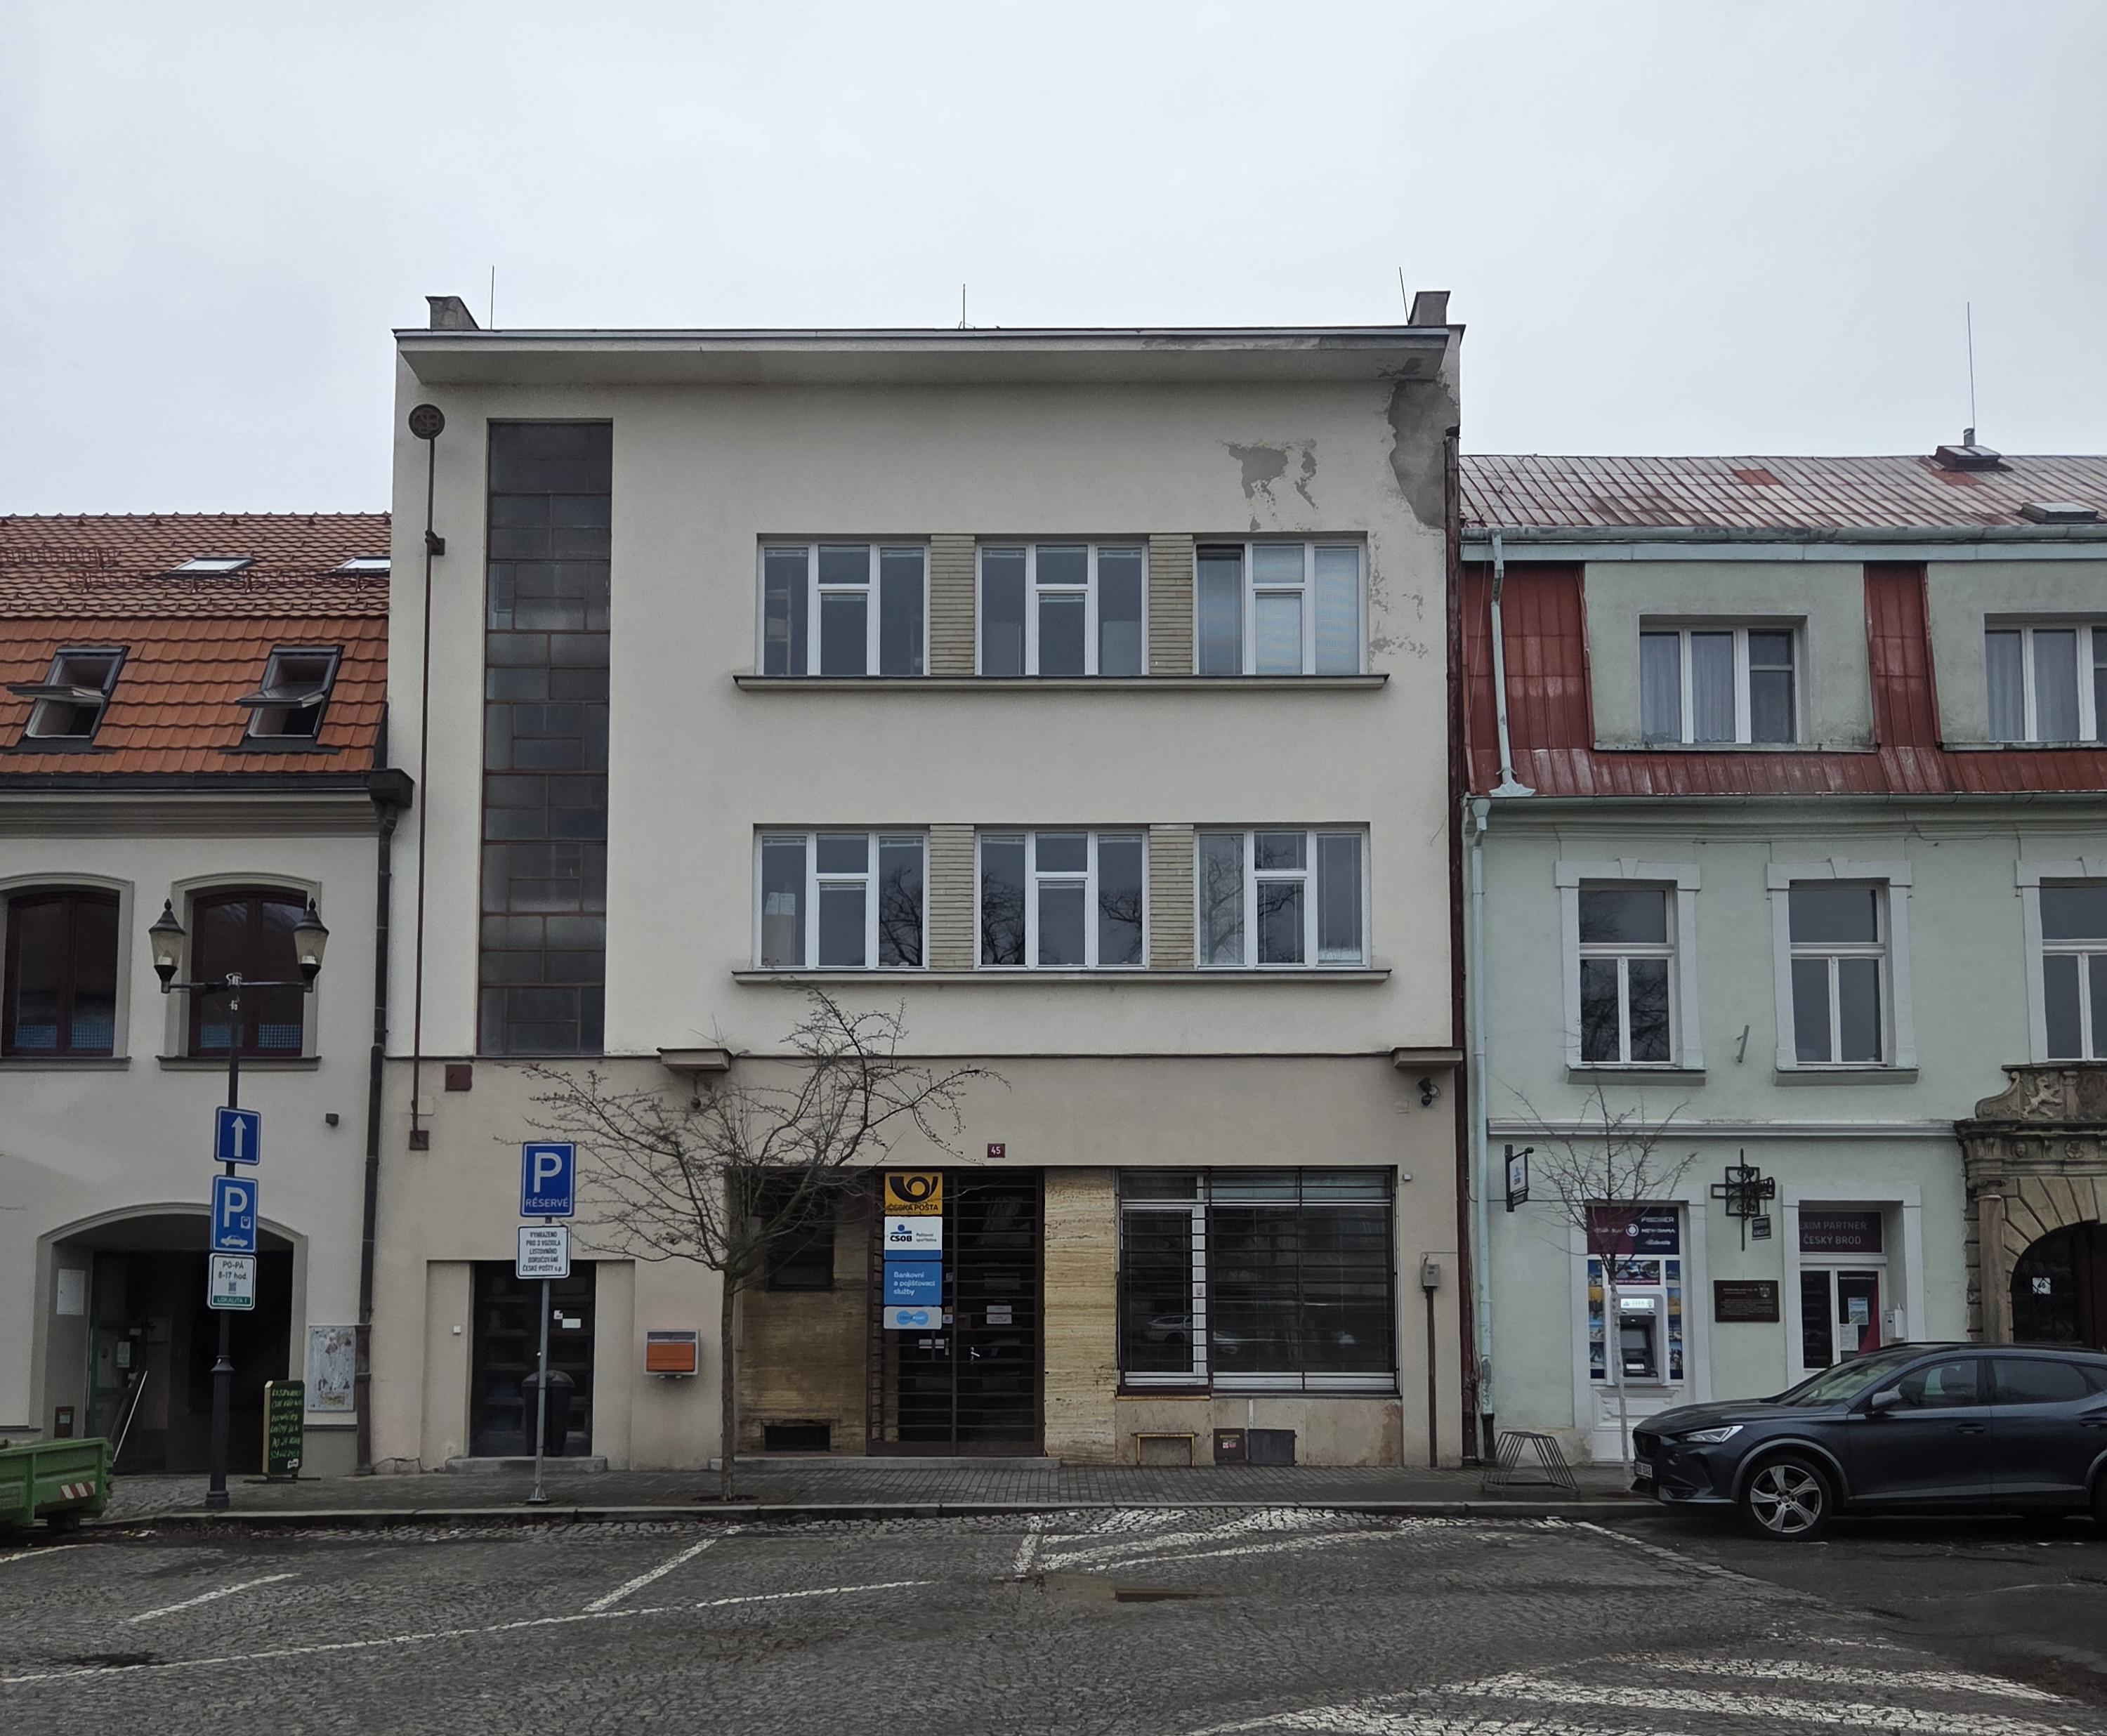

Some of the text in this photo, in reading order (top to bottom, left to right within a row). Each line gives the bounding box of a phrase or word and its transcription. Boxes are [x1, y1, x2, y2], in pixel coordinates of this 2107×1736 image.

[991, 1146, 1001, 1155] 45
[534, 1152, 562, 1192] P
[223, 1186, 248, 1228] P
[526, 1197, 569, 1207] RÉSERVÉ
[1803, 1233, 1861, 1244] ČESKÝ BROD
[223, 1260, 244, 1269] PO-PÁ
[218, 1270, 232, 1279] 8-17
